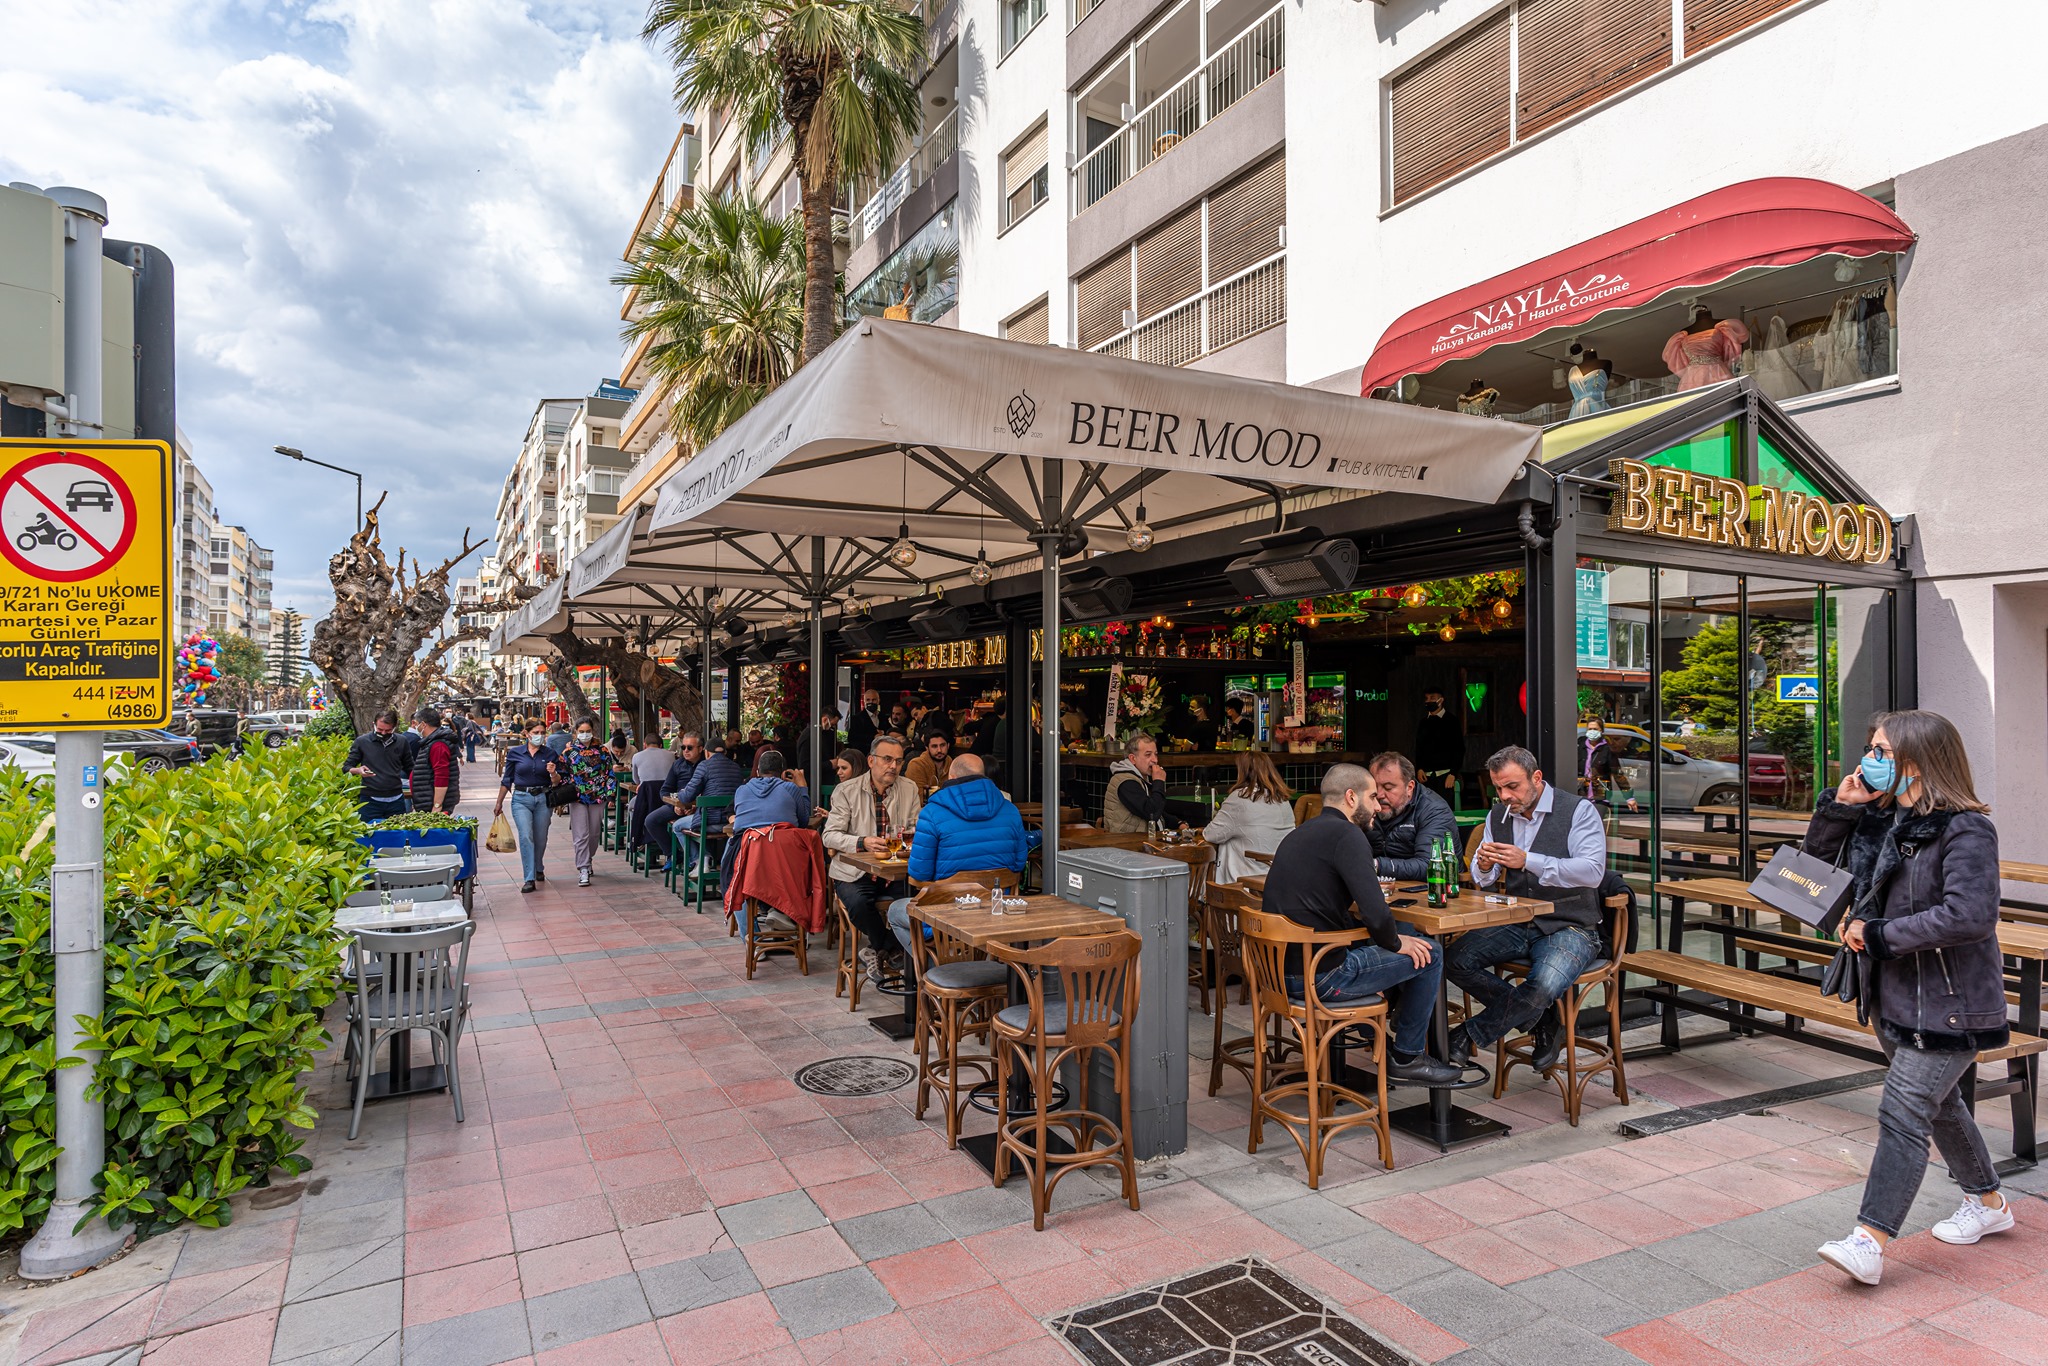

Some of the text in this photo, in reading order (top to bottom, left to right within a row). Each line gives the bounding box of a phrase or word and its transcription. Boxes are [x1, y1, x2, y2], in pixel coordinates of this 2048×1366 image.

[1472, 279, 1576, 331] NAYLA
[1068, 401, 1418, 480] BEER MOOD PUB & KITCHEN
[702, 448, 745, 502] MOOD
[1608, 457, 1892, 564] BEER MOOD
[97, 585, 160, 598] UKOME
[4, 599, 125, 614] Kararı Gereği
[76, 617, 98, 626] ve
[105, 614, 157, 626] Pazar
[30, 627, 100, 639] Günleri
[41, 642, 81, 660] Araç
[85, 641, 158, 659] Trafiğine
[927, 640, 974, 669] BEER
[25, 661, 106, 679] Kapalıdır.
[73, 686, 105, 700] 444
[107, 703, 157, 719] (4986)
[1085, 941, 1112, 959] %100
